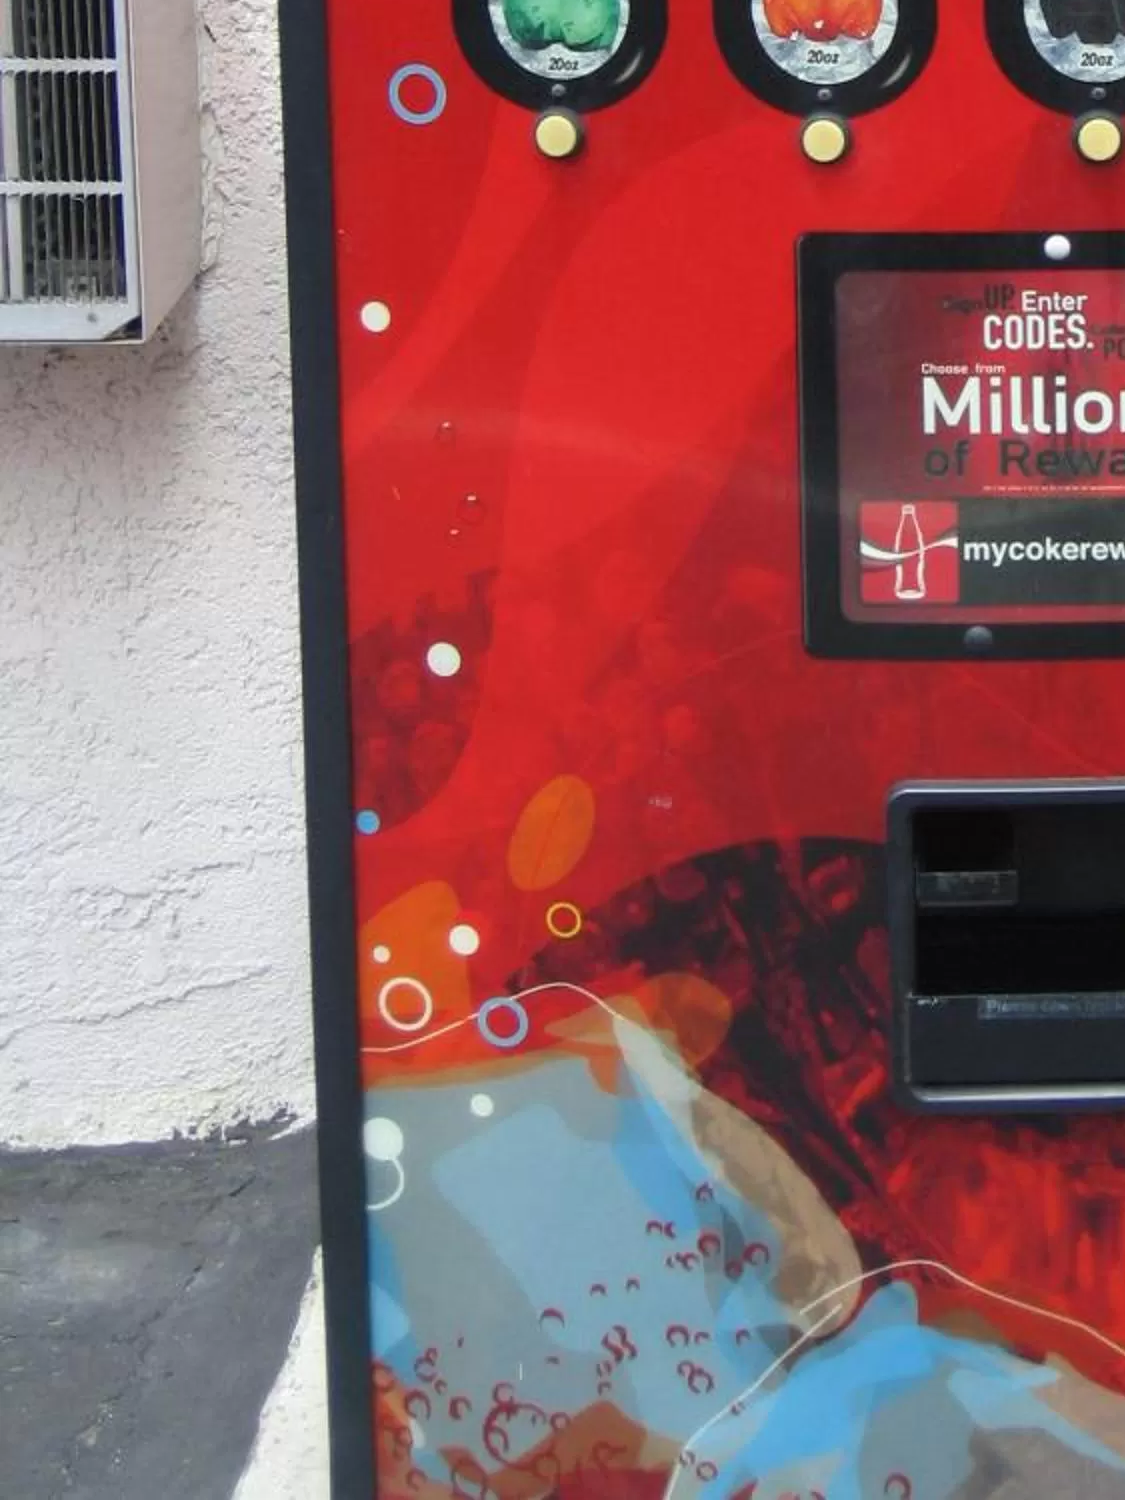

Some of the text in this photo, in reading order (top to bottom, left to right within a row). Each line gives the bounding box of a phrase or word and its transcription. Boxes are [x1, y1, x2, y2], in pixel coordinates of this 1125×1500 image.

[1021, 290, 1088, 312] Enter
[983, 314, 1094, 350] CODES.
[921, 363, 1006, 375] Choose from
[924, 440, 969, 477] of
